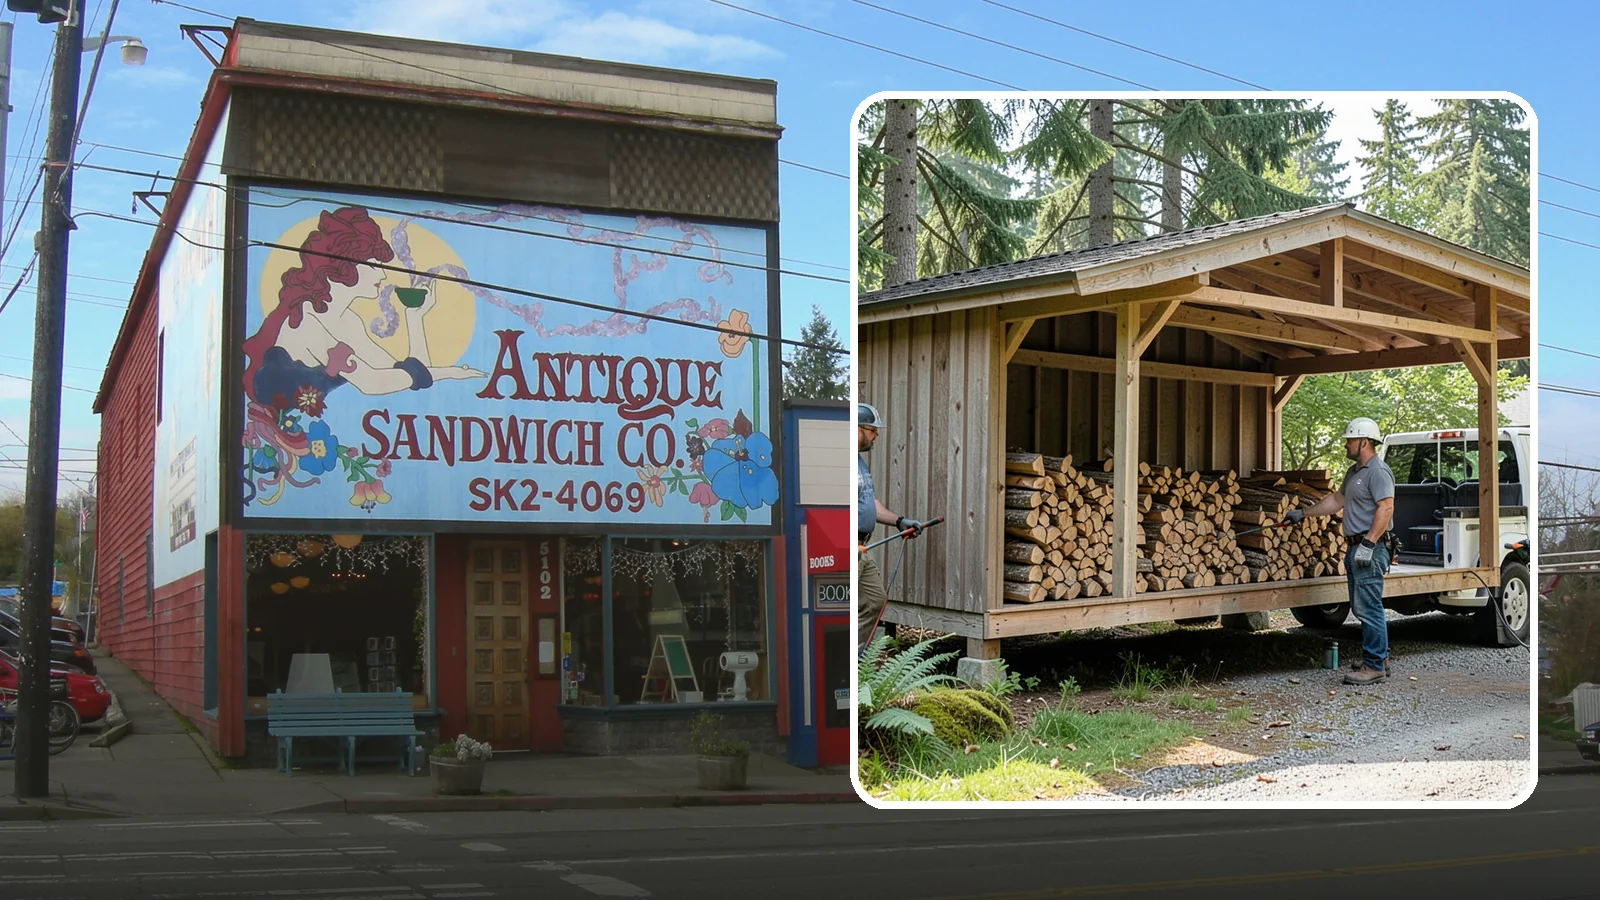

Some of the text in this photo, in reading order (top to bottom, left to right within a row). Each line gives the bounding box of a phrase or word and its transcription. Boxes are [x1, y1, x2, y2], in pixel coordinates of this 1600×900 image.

[476, 329, 724, 421] ANTIQUE
[361, 408, 685, 469] SANDWICH CO.
[468, 476, 646, 513] SK2-4069
[539, 541, 552, 600] 5102
[809, 555, 835, 569] BOOKS
